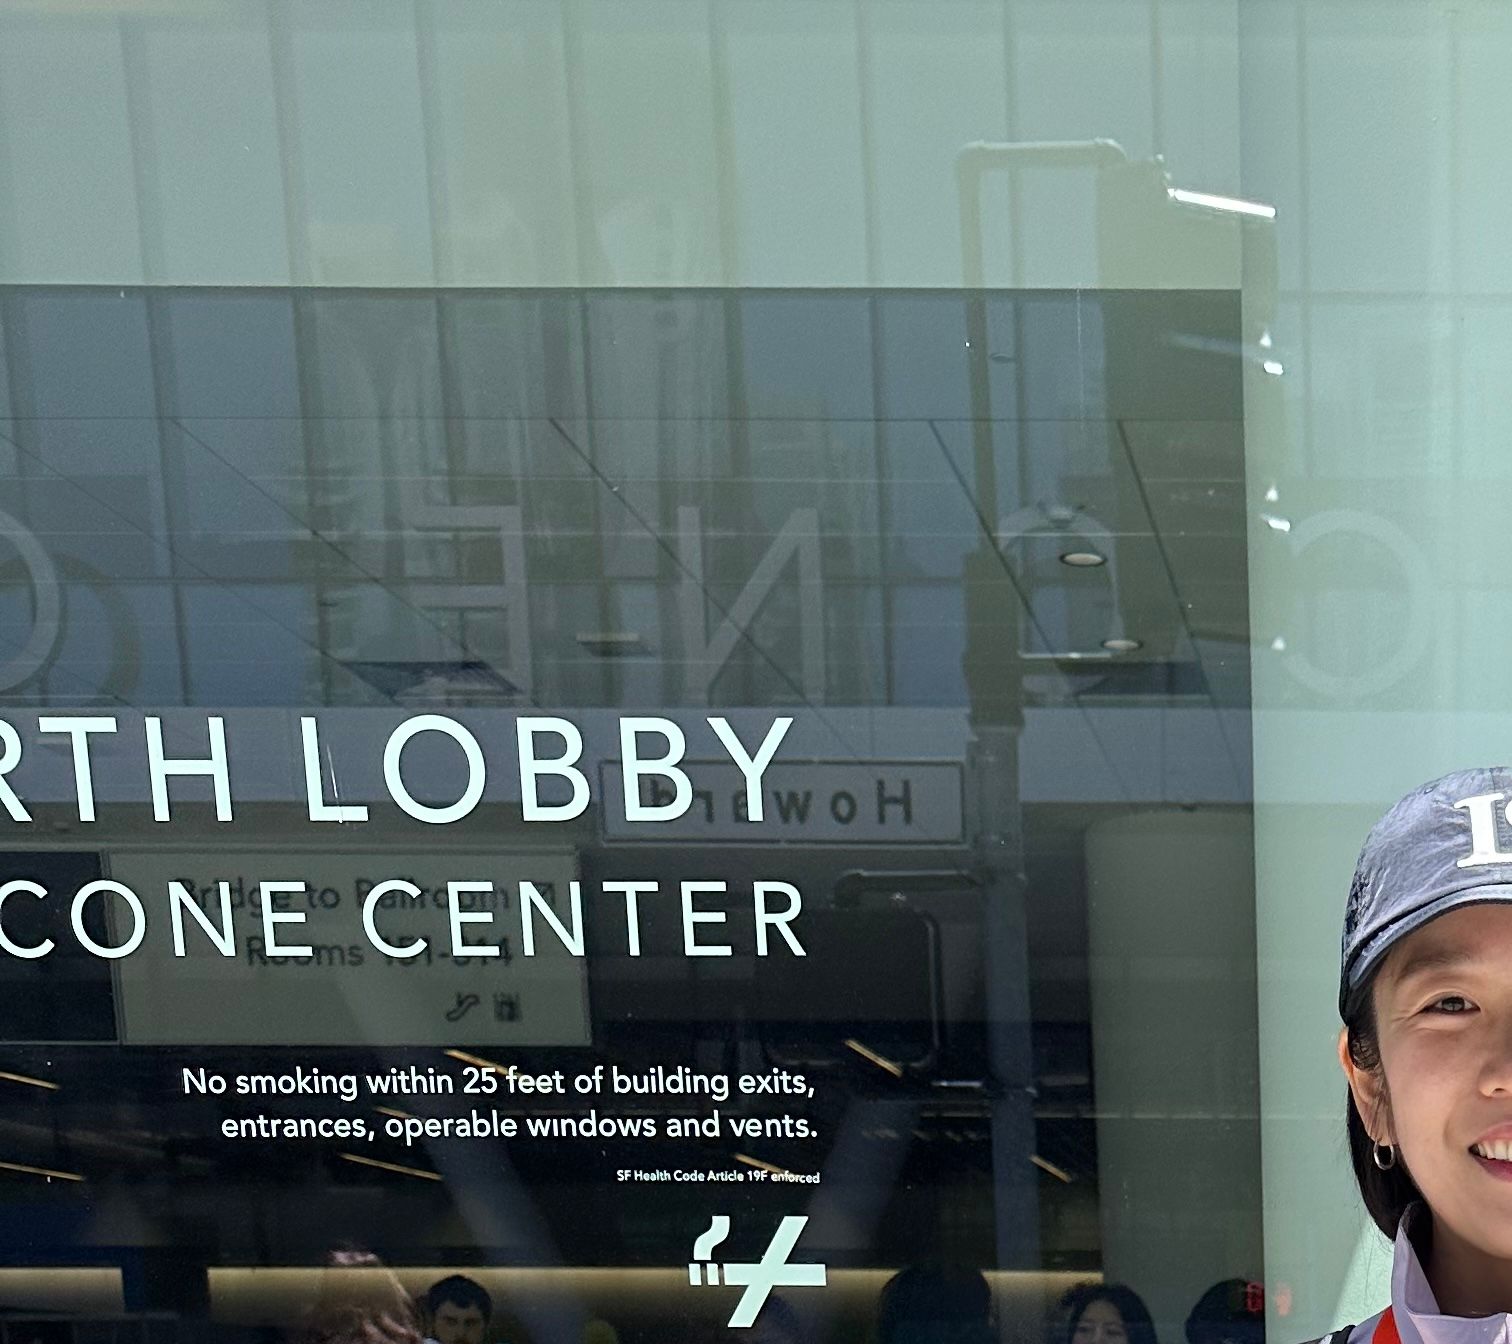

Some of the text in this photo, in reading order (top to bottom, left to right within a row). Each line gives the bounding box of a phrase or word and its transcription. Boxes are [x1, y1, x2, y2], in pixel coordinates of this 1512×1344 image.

[300, 714, 794, 824] LOBBY
[306, 881, 342, 910] to
[0, 879, 807, 959] CONE CENTER
[182, 1065, 815, 1102] No smoking within 25 feet of building exits,
[221, 1109, 818, 1147] entrances, operable windows and vents.
[616, 1168, 821, 1184] SF Health Code Article 19F enforced
